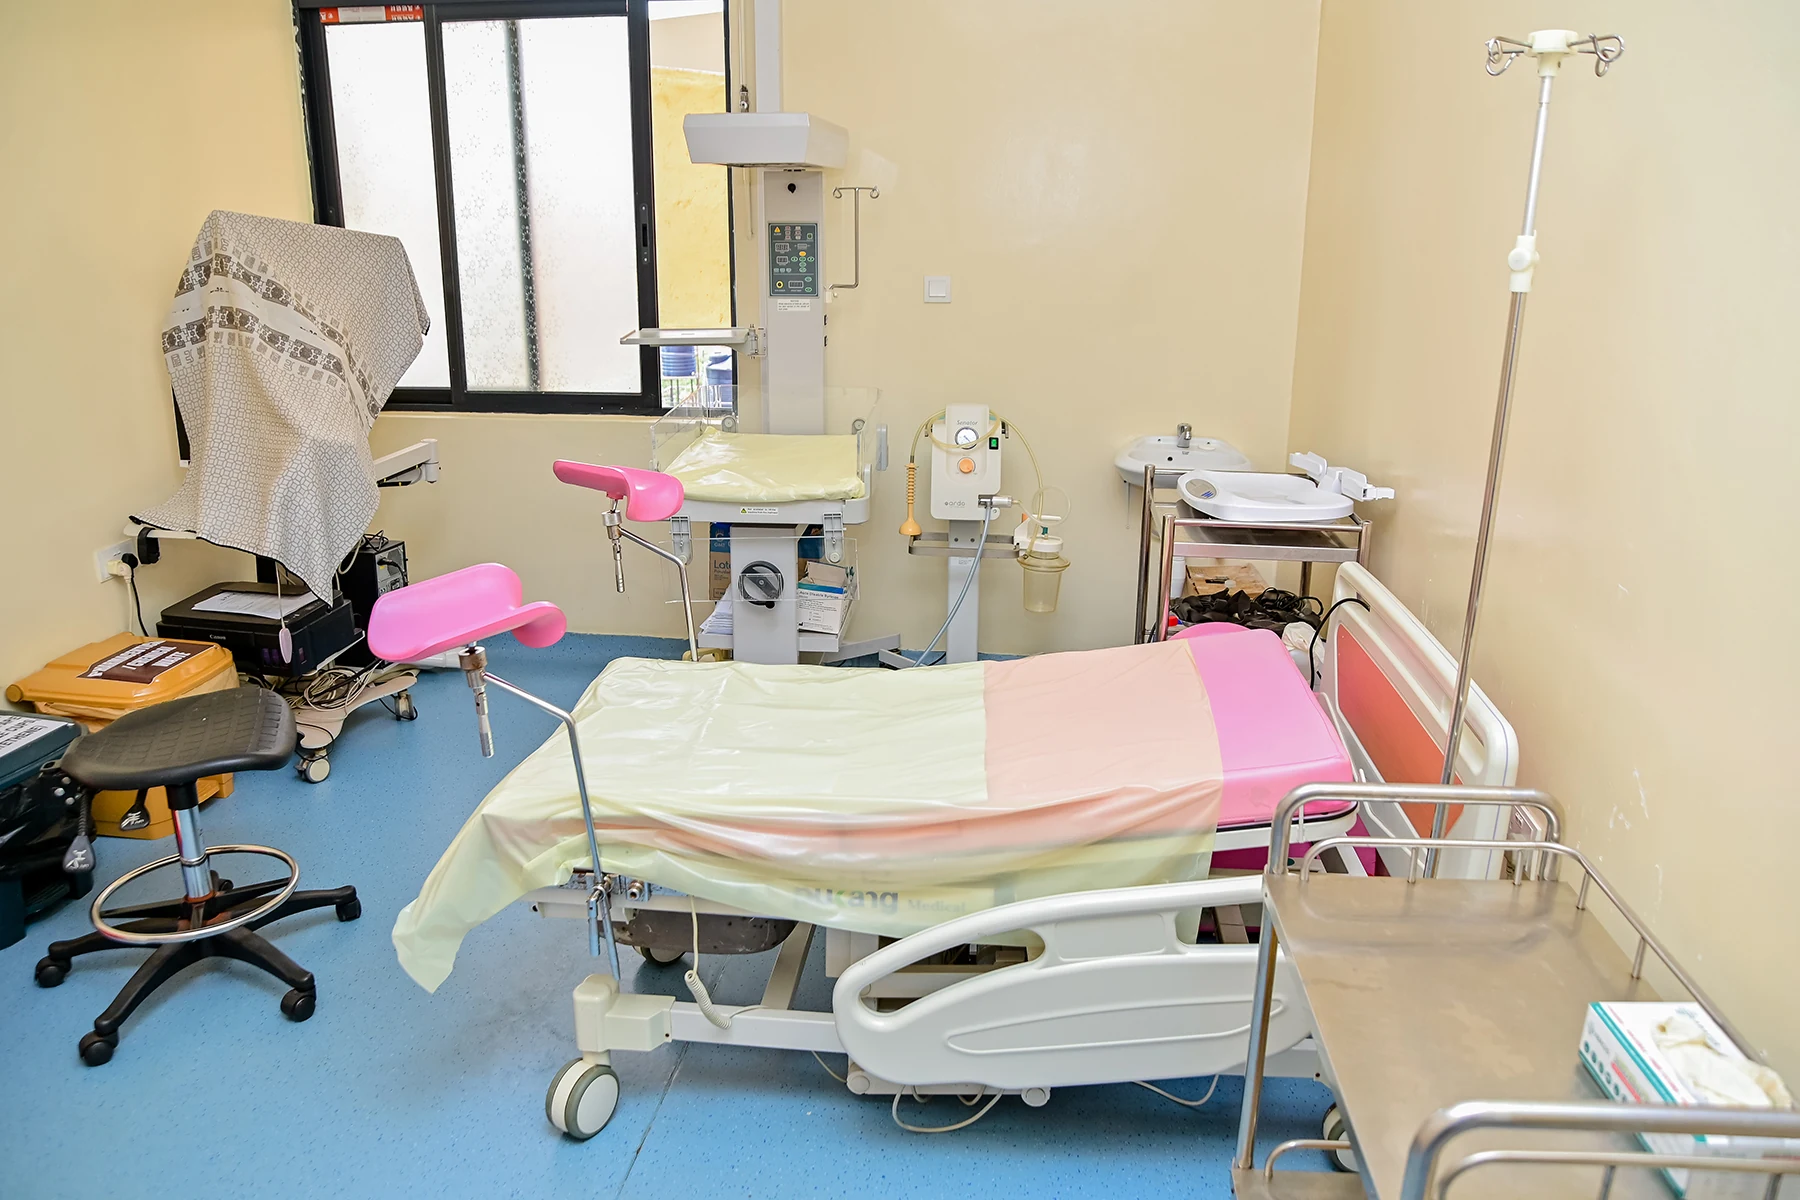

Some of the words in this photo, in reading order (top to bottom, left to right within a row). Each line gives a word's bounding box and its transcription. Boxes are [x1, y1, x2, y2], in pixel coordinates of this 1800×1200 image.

[209, 633, 227, 641] Canon
[151, 651, 191, 667] WASTE
[908, 899, 967, 913] Medical
